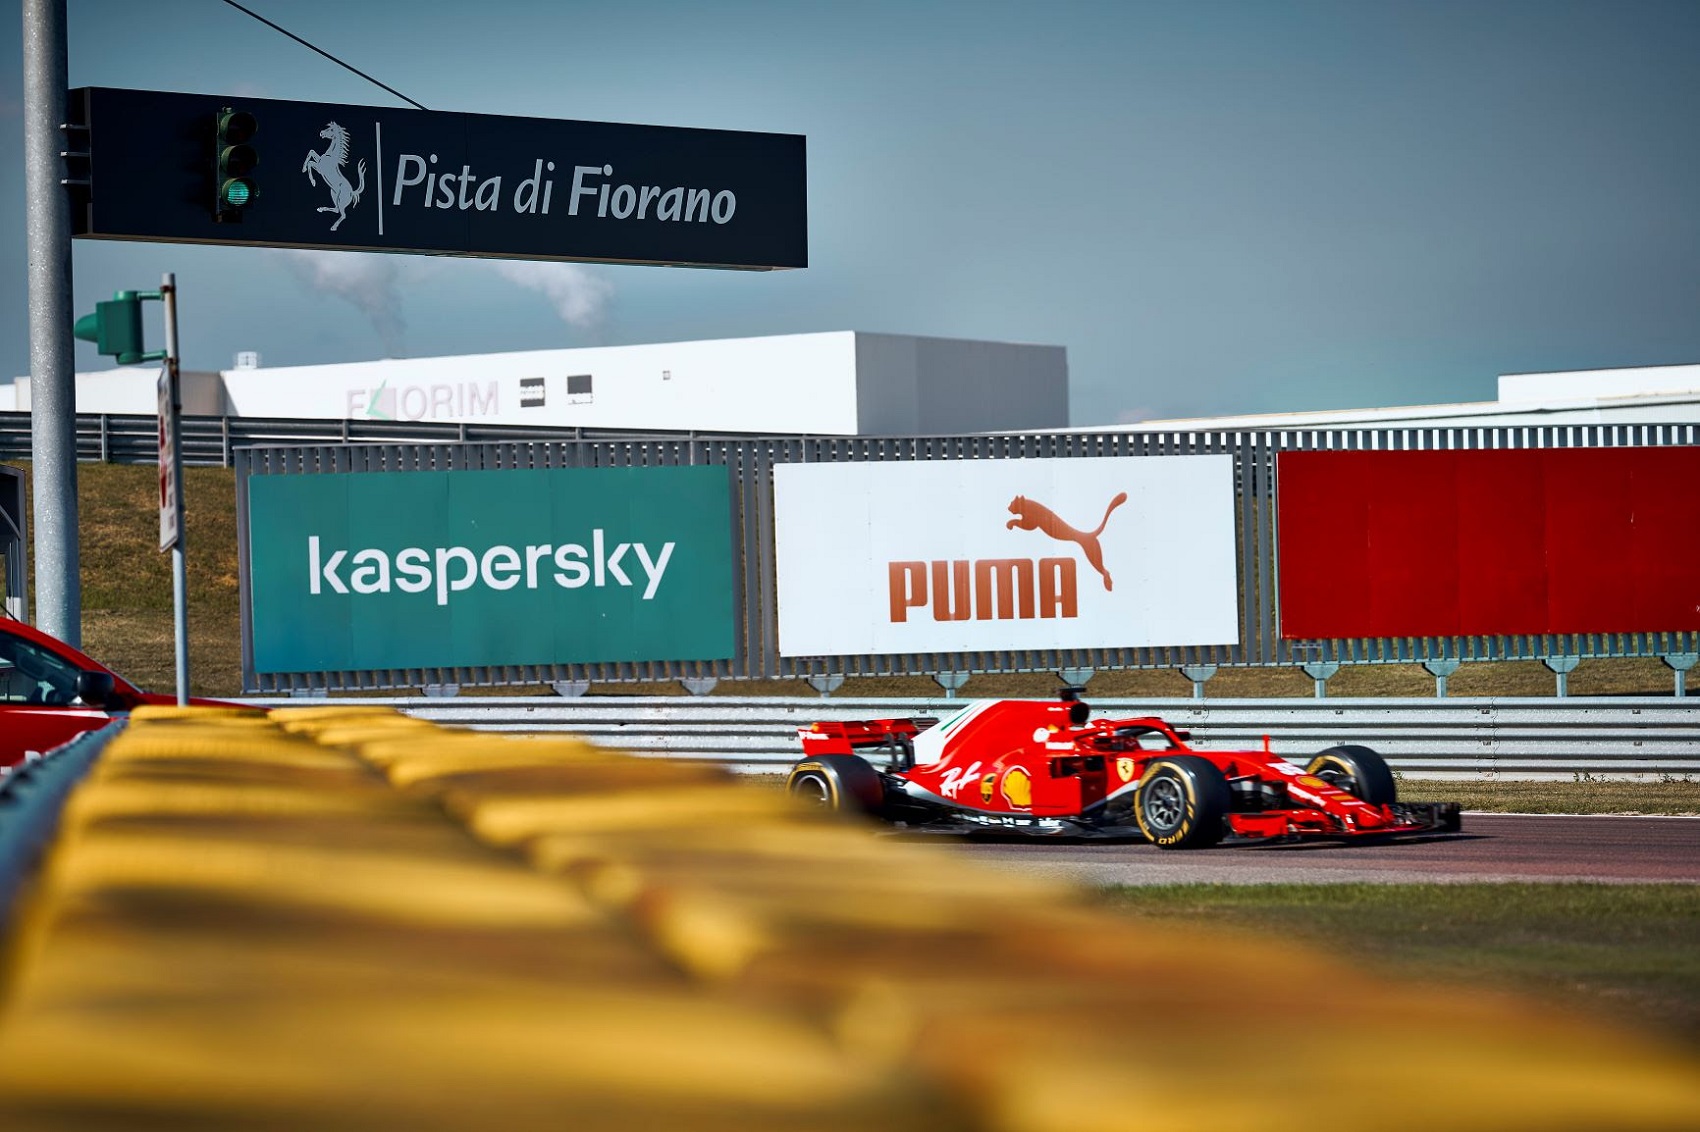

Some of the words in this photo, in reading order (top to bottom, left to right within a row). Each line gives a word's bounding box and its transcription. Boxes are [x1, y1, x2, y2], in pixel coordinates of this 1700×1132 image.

[393, 154, 502, 212] Pista
[514, 157, 555, 215] di
[567, 164, 737, 225] Fiorano
[308, 528, 676, 606] kaspersky
[888, 557, 1079, 623] PUMA
